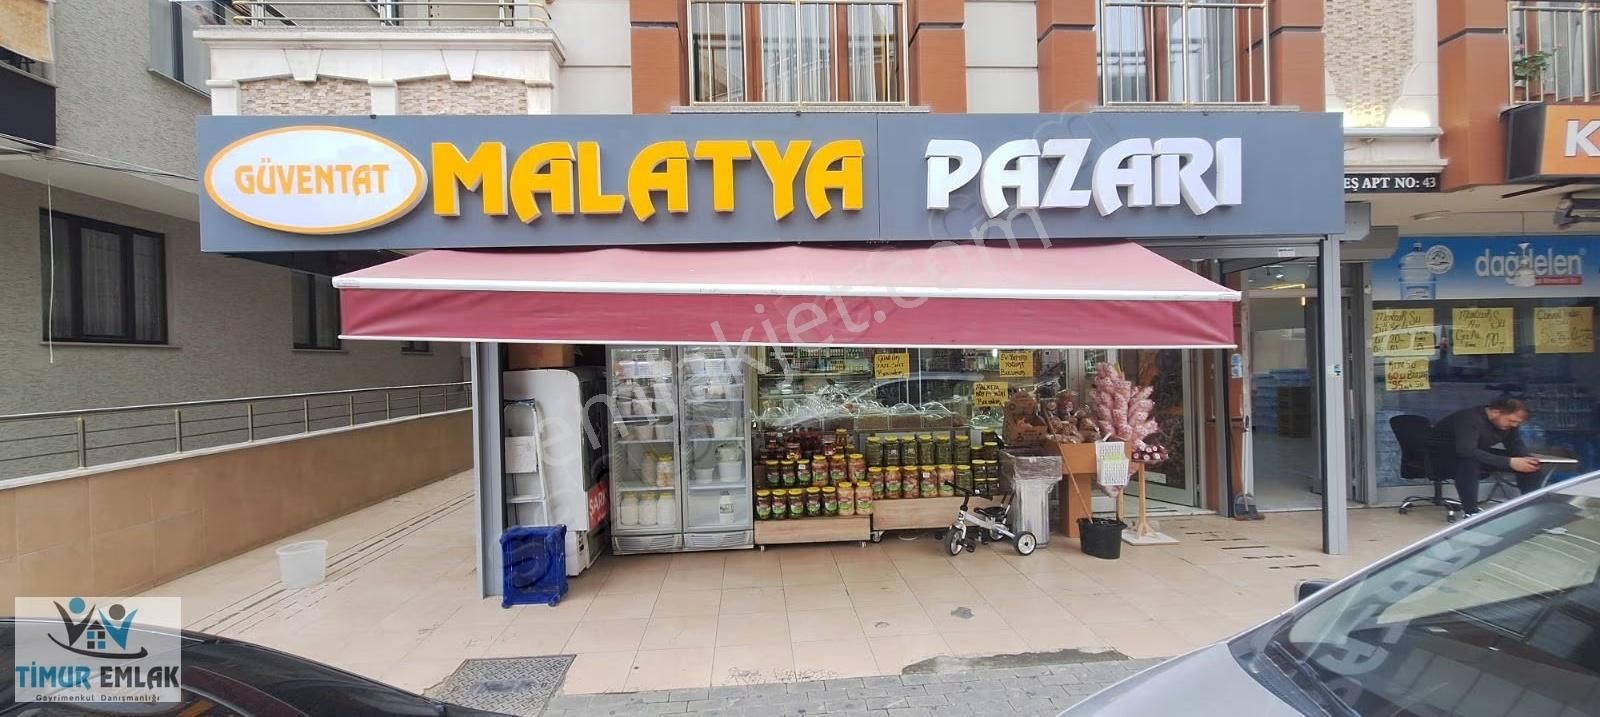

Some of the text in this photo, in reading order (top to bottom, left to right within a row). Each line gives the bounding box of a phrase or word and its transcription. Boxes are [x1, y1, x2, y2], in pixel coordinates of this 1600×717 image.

[234, 157, 390, 198] GÜVENTAT
[431, 137, 1242, 222] MALATYA PAZARI
[1362, 177, 1390, 189] APT
[1395, 177, 1420, 189] NO:
[1422, 177, 1436, 188] 43
